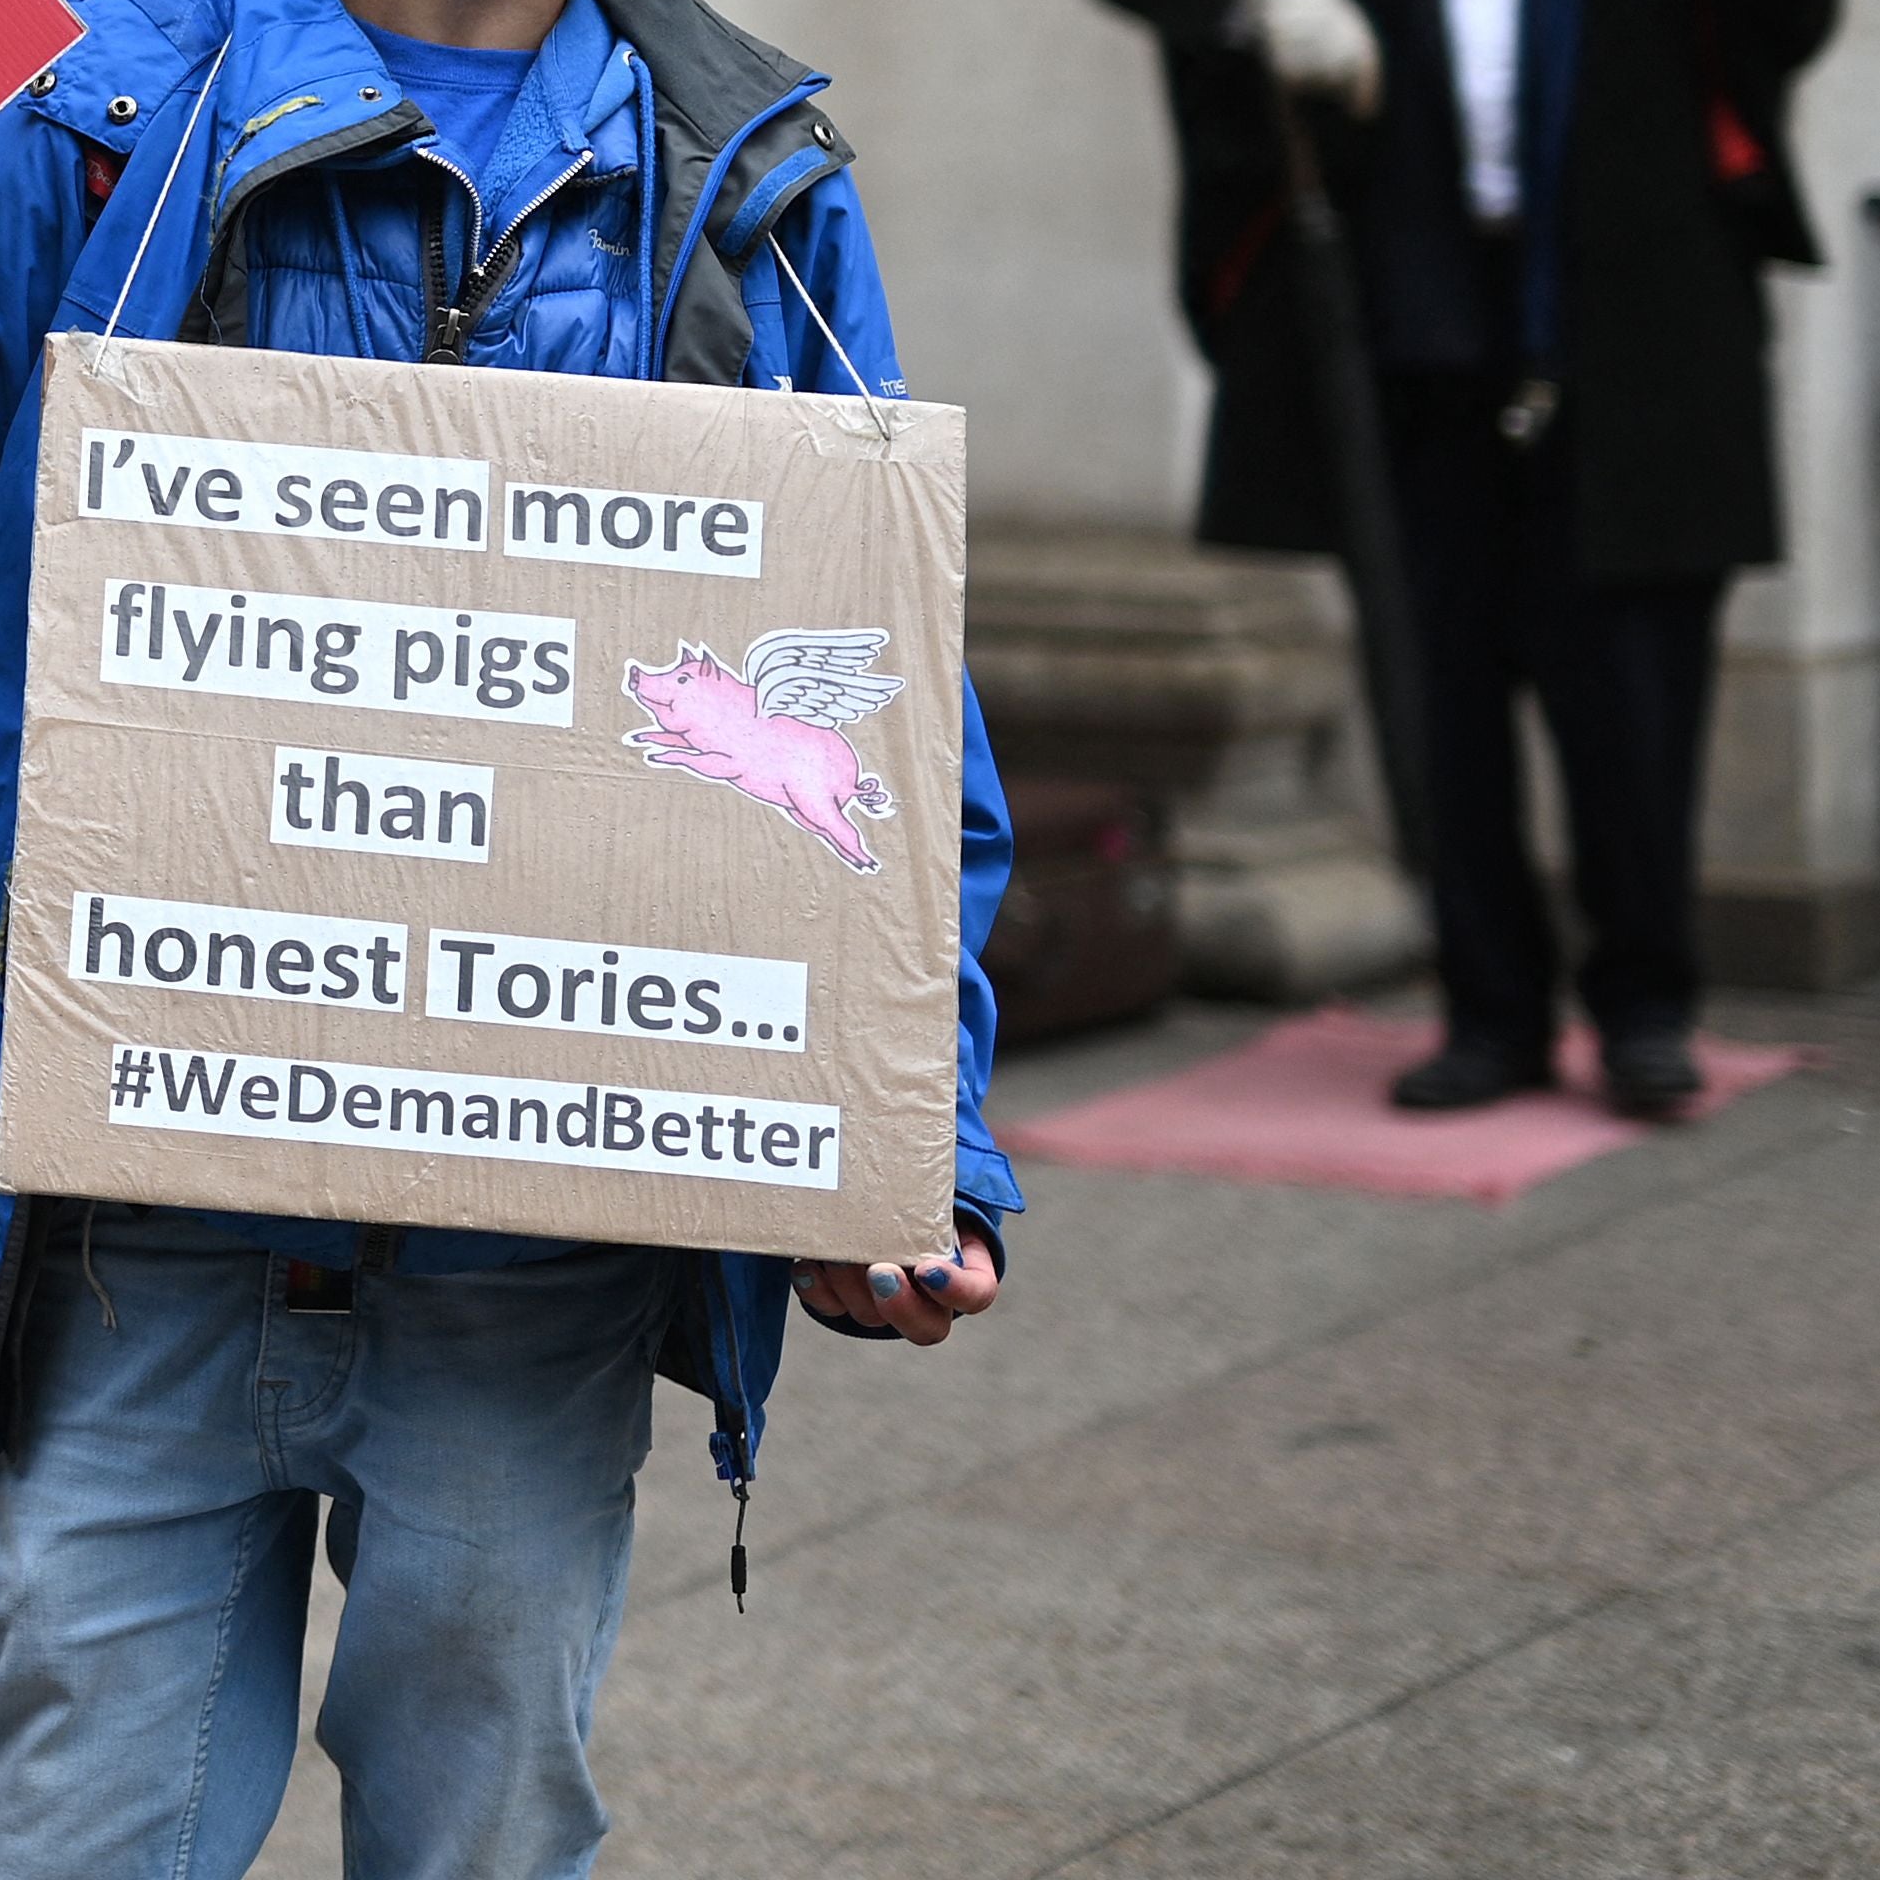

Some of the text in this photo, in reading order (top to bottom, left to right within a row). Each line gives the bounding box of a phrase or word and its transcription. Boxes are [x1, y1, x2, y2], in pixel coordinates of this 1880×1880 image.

[274, 470, 485, 543] seen
[511, 482, 750, 558] more
[109, 583, 572, 710] flying pigs
[280, 756, 487, 846] than
[83, 896, 799, 1042] honest Tories...
[111, 1051, 837, 1171] #WeDemandBetter
